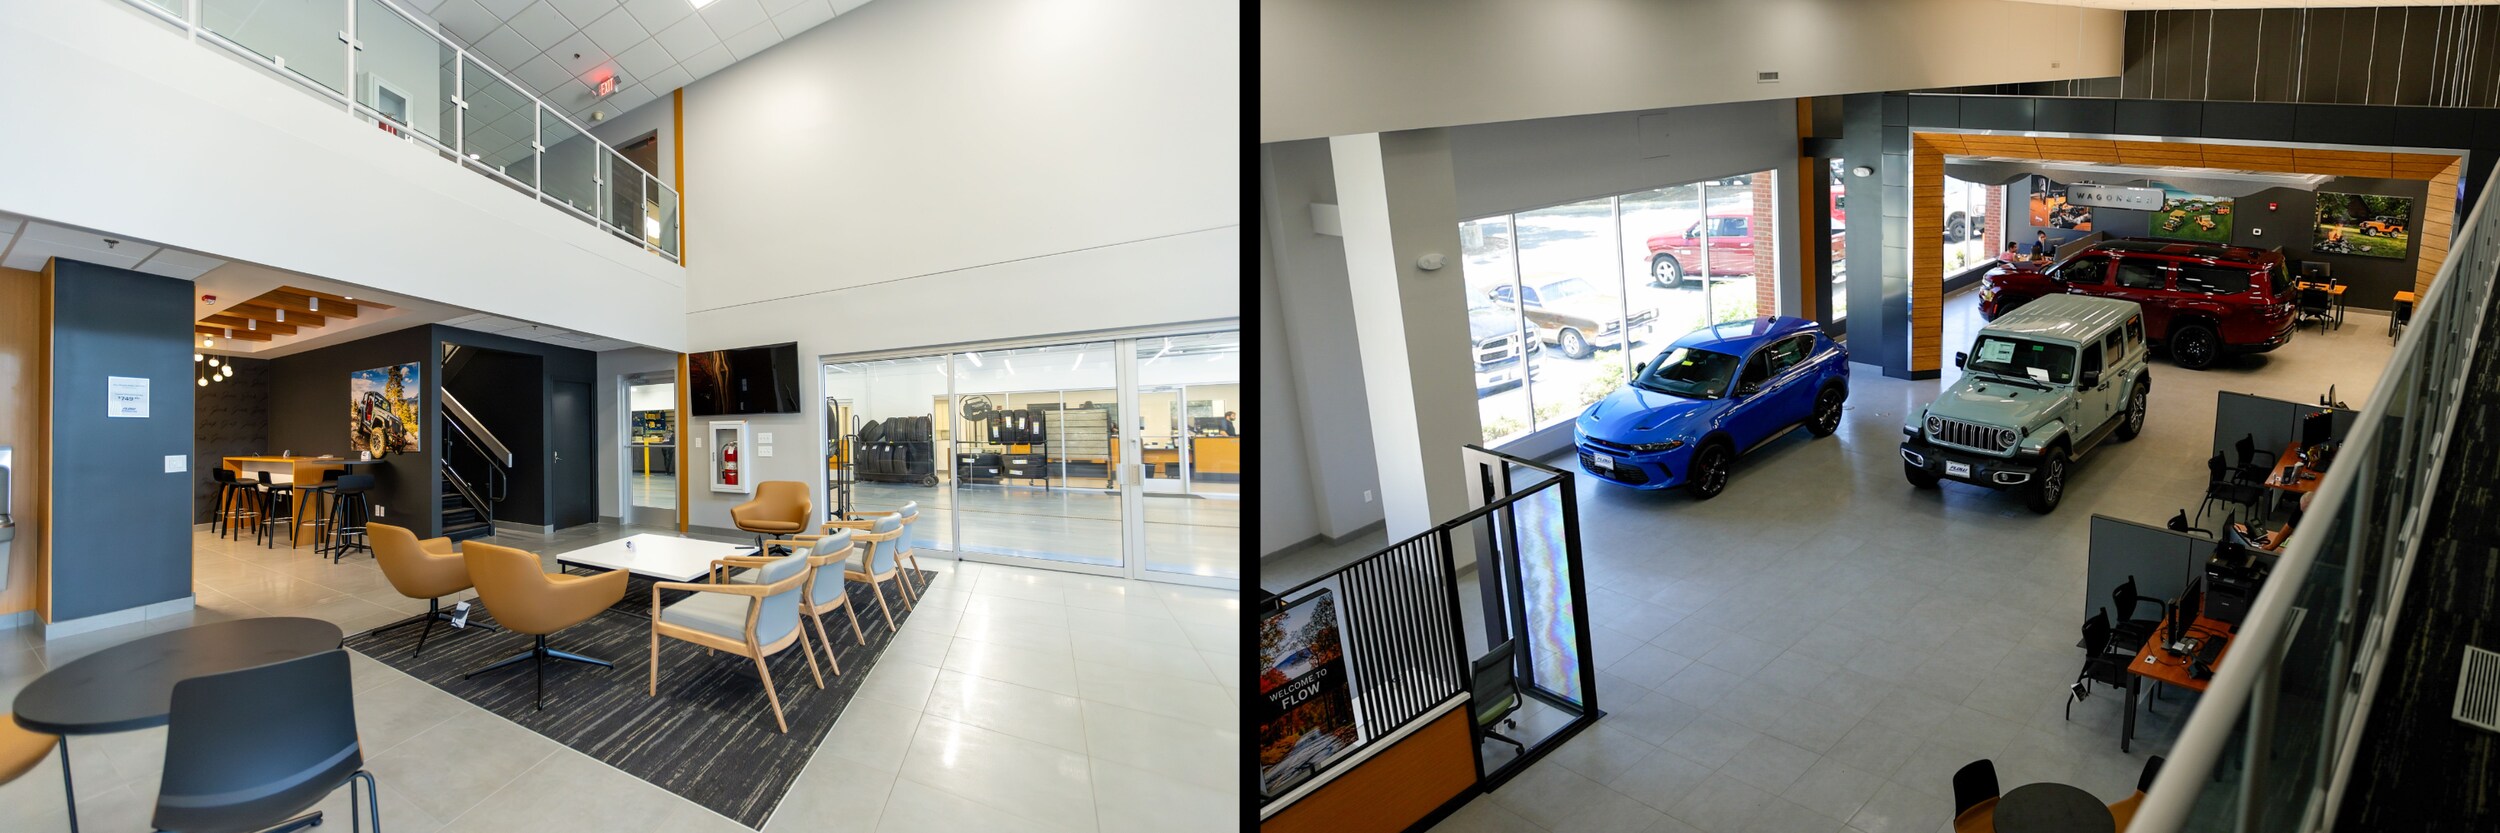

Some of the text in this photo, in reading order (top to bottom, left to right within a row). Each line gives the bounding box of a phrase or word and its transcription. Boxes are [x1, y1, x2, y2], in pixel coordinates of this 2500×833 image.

[600, 77, 614, 97] EXIT
[1269, 668, 1327, 702] WELCOME TO
[1281, 681, 1320, 710] FLOW
